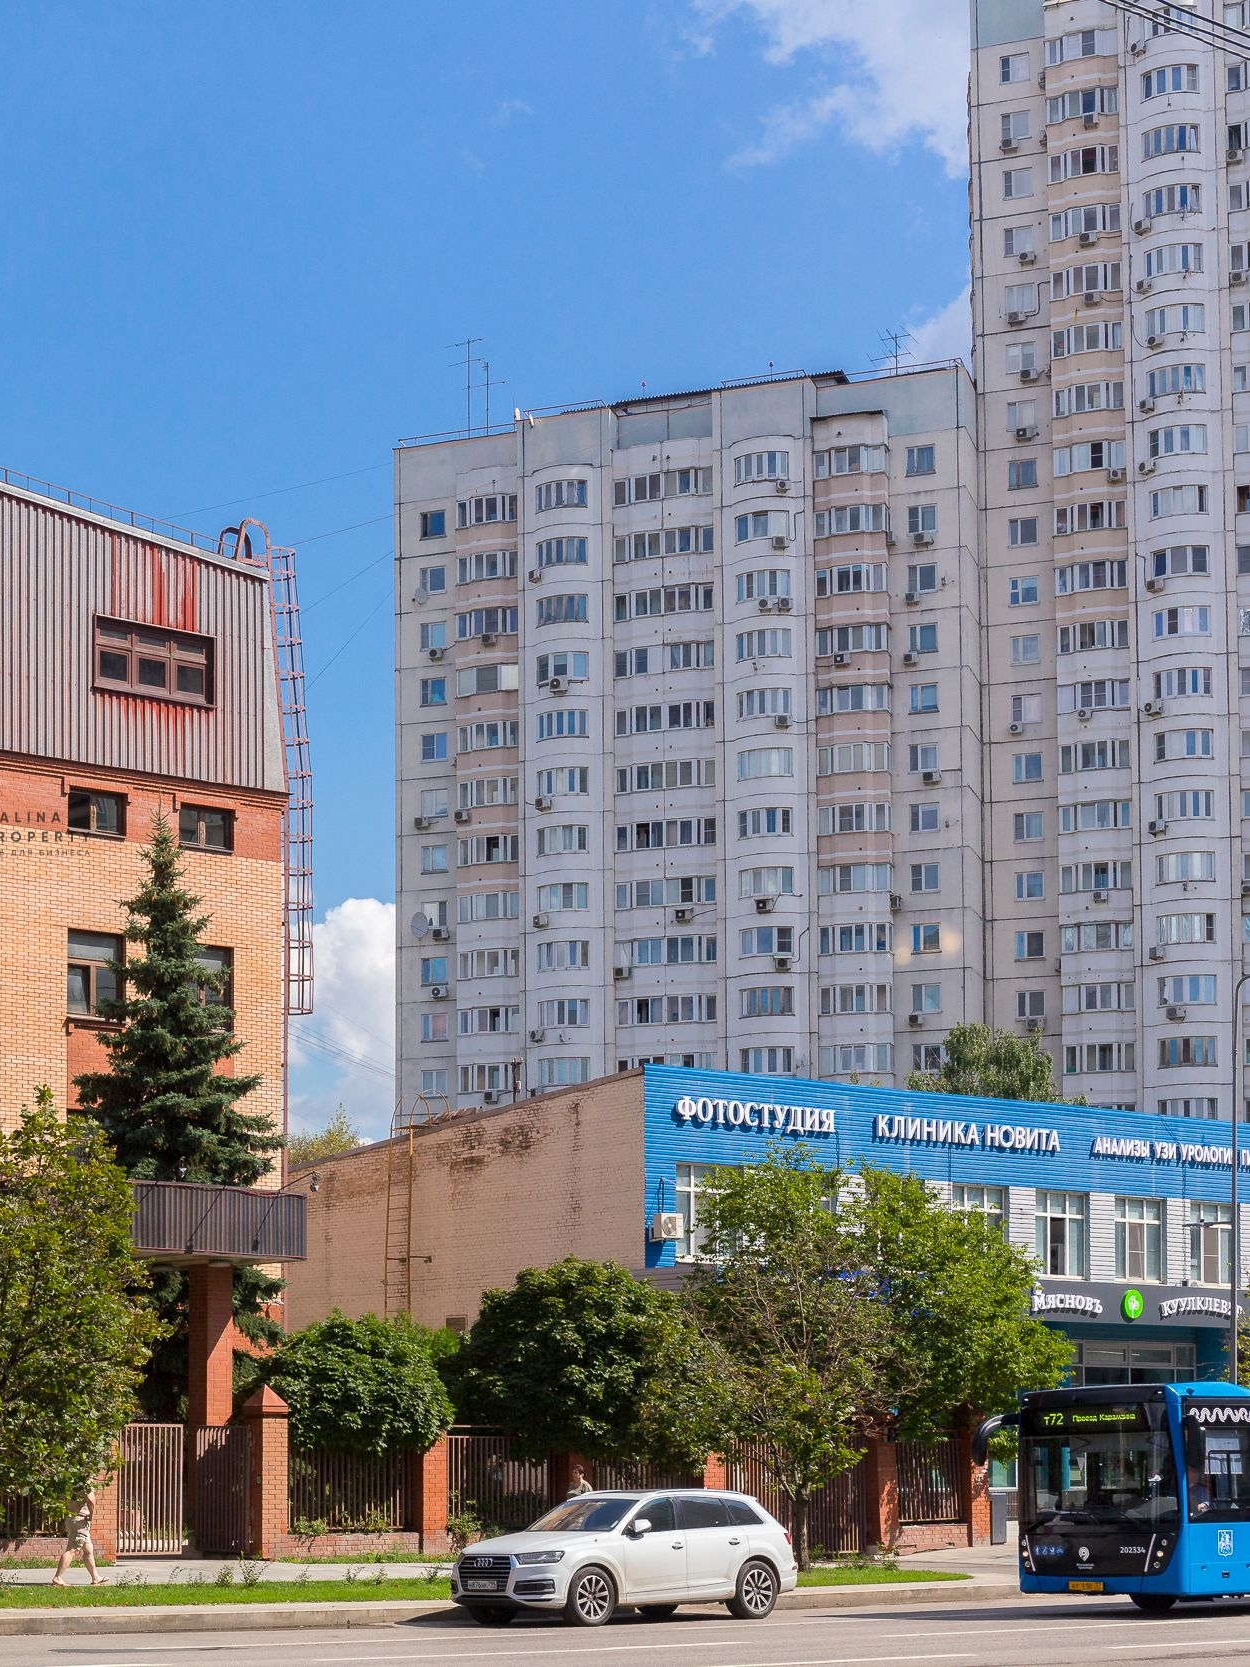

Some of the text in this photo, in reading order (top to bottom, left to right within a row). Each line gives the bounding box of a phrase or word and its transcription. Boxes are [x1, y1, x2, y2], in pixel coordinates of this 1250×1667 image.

[677, 1095, 836, 1135] ФОТОСТУДИЯ
[877, 1114, 1061, 1152] КЛИНИКА НОВИТА
[1094, 1136, 1150, 1158] АНАЛИЗЫ
[1153, 1142, 1177, 1160] УЗИ
[1180, 1143, 1236, 1165] УРОЛОГИ
[1119, 1546, 1146, 1554] 202334
